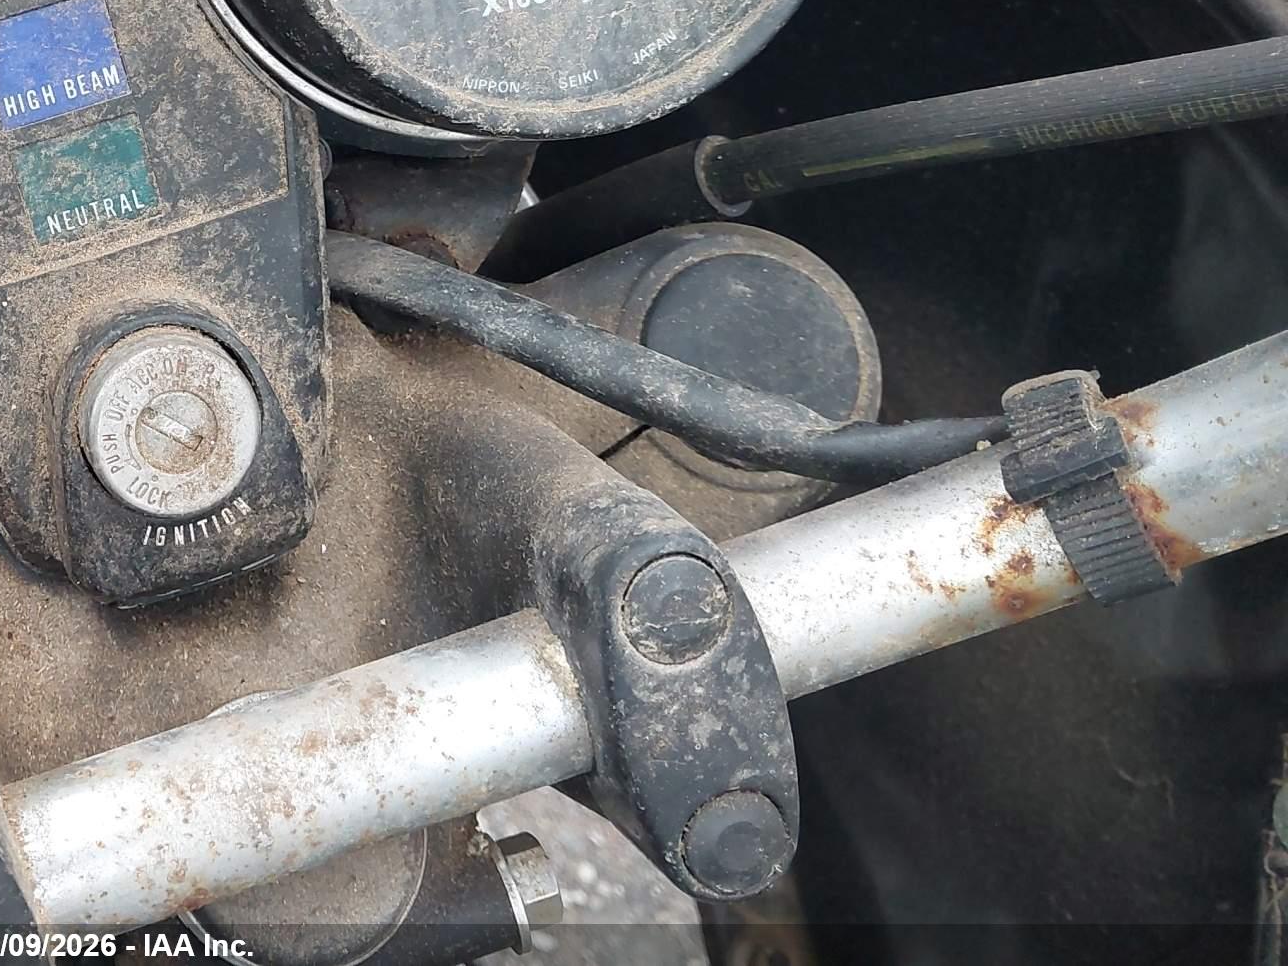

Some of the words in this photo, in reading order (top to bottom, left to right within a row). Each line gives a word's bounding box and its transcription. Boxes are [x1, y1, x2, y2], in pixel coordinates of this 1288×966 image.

[462, 76, 521, 94] NIPPON
[558, 69, 600, 90] SEIKI
[632, 28, 678, 66] JAPAN
[4, 82, 57, 117] HIGH
[65, 65, 121, 100] BEAM
[46, 188, 146, 235] NEUTRAL
[126, 362, 159, 395] ACC
[104, 389, 132, 422] OFF
[102, 433, 125, 475] PUSH
[125, 476, 171, 510] LOCK
[143, 496, 252, 546] IGNITION
